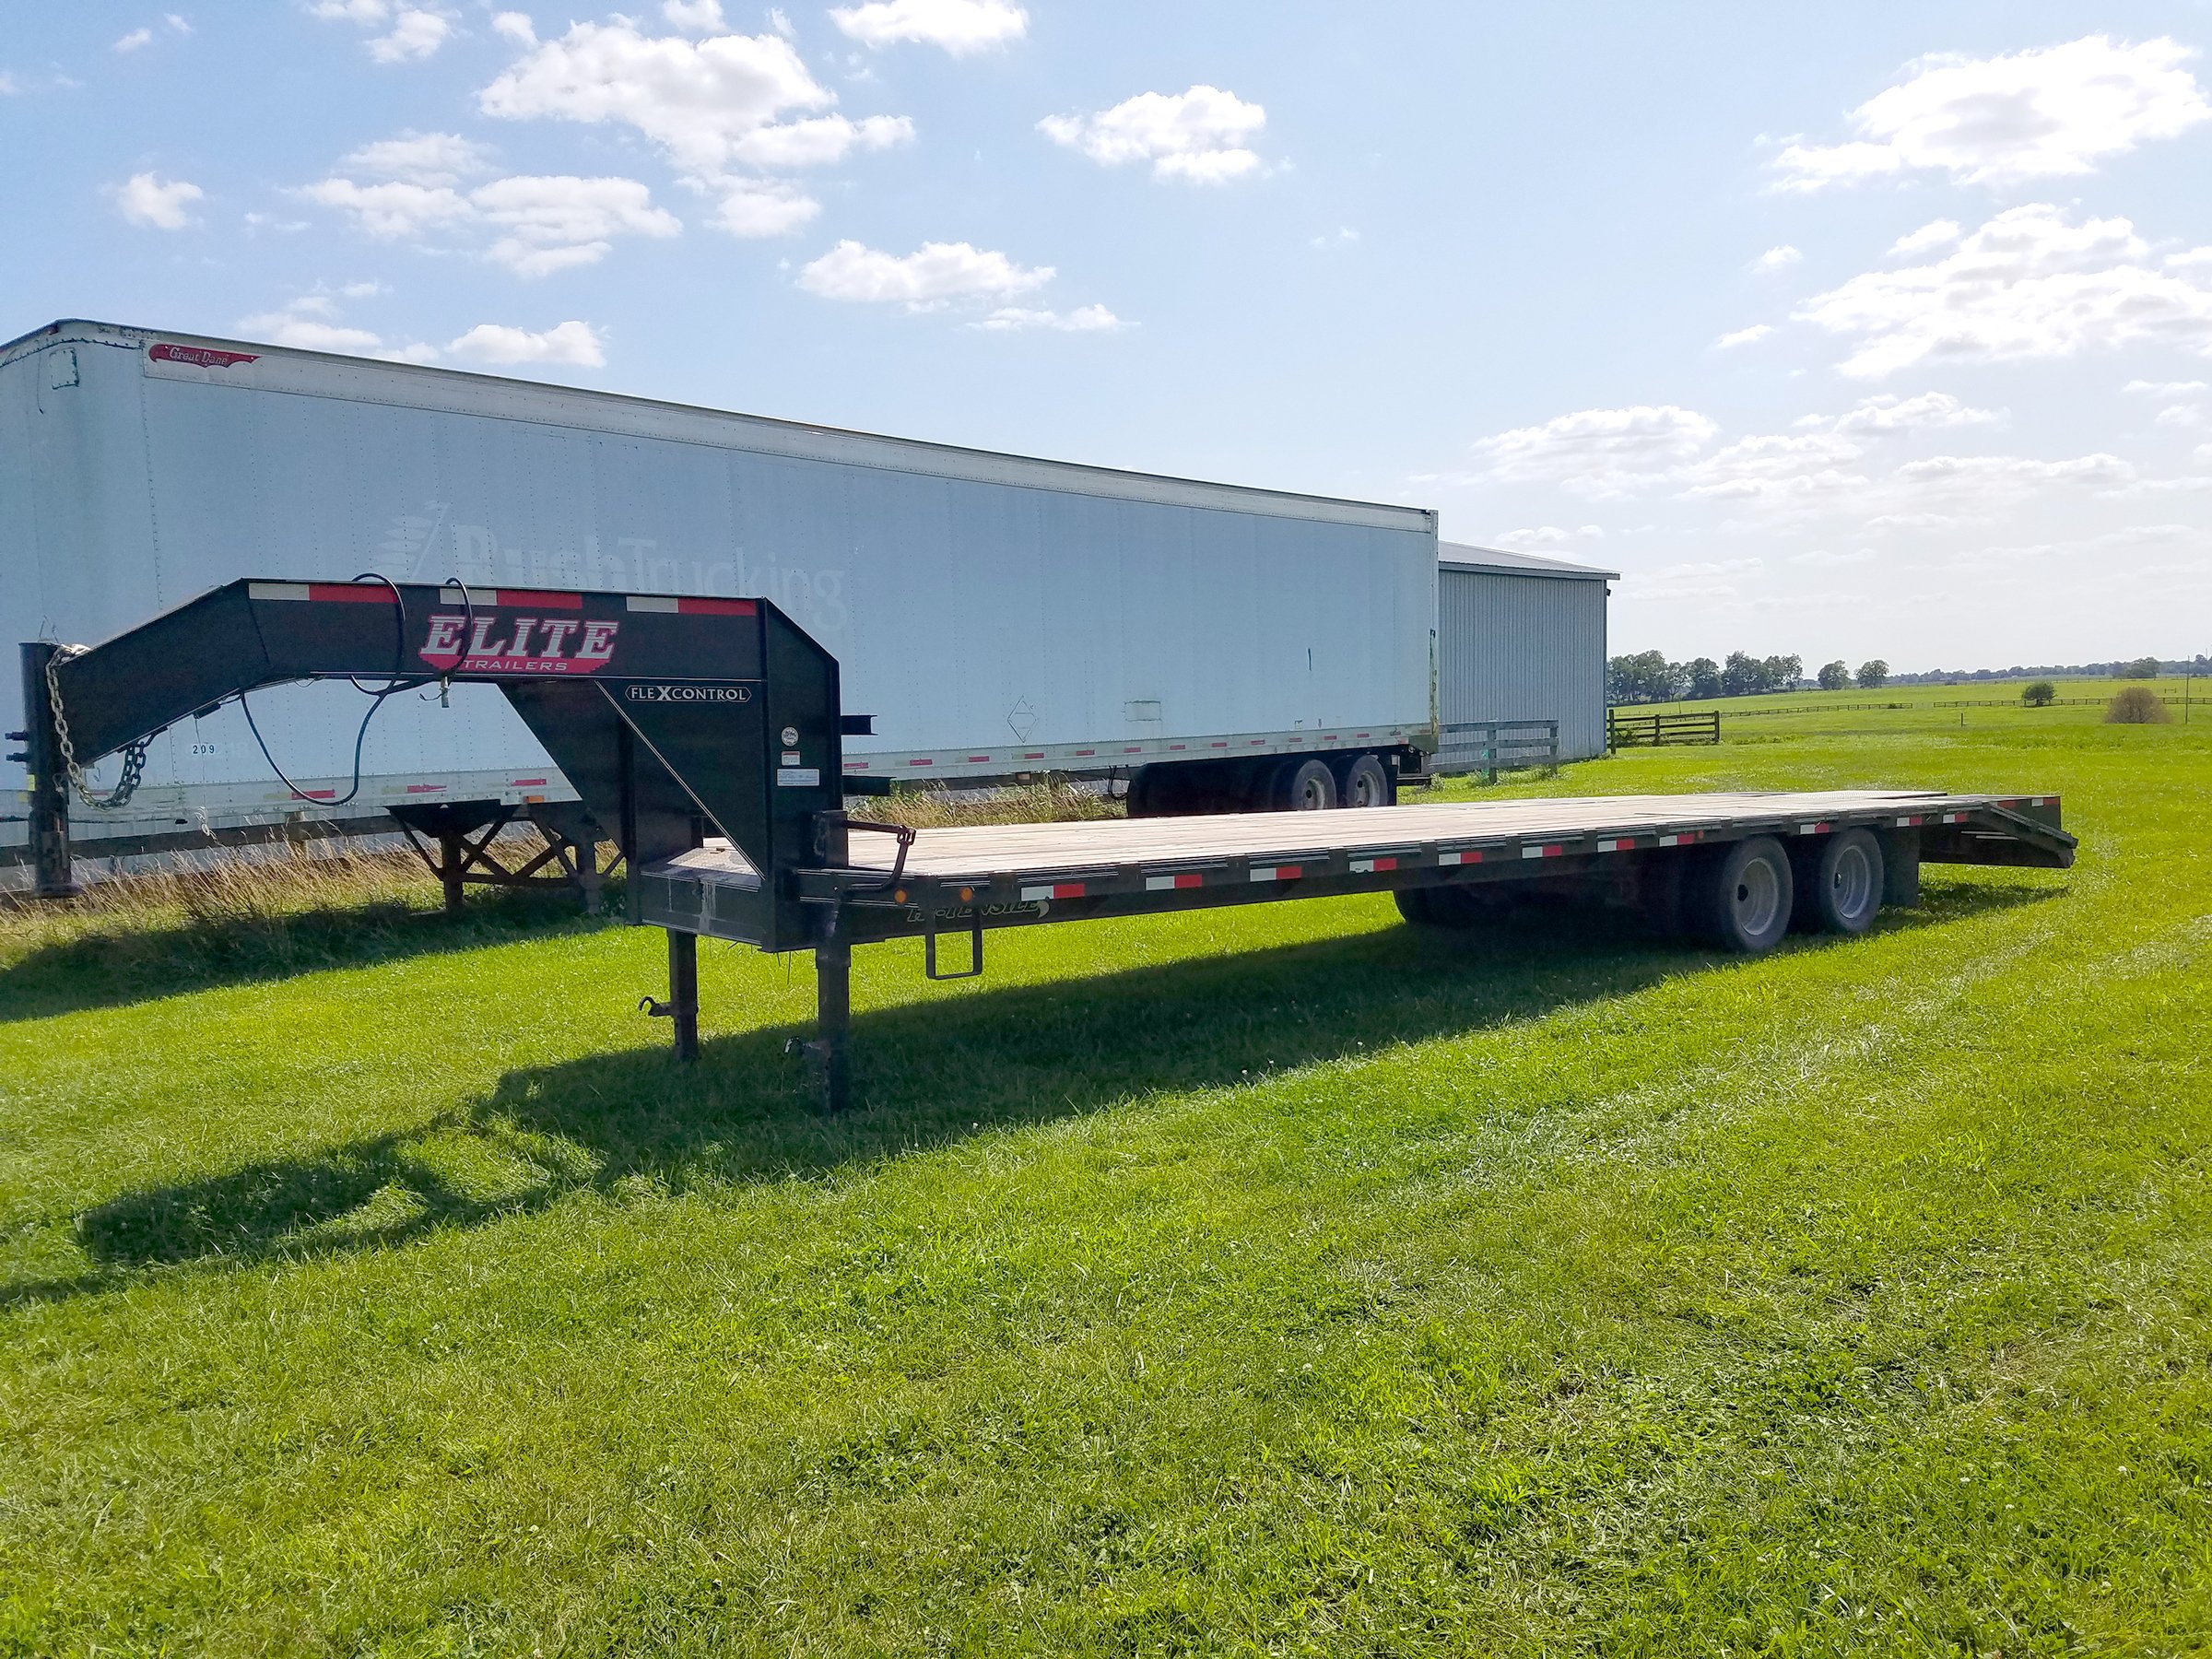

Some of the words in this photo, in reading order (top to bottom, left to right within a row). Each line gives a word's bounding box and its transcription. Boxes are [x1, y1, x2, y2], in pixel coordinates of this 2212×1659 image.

[169, 347, 199, 362] Great
[200, 352, 229, 366] Dane
[419, 615, 619, 660] ELITE
[464, 659, 568, 671] TRAILERS
[193, 745, 215, 754] 209
